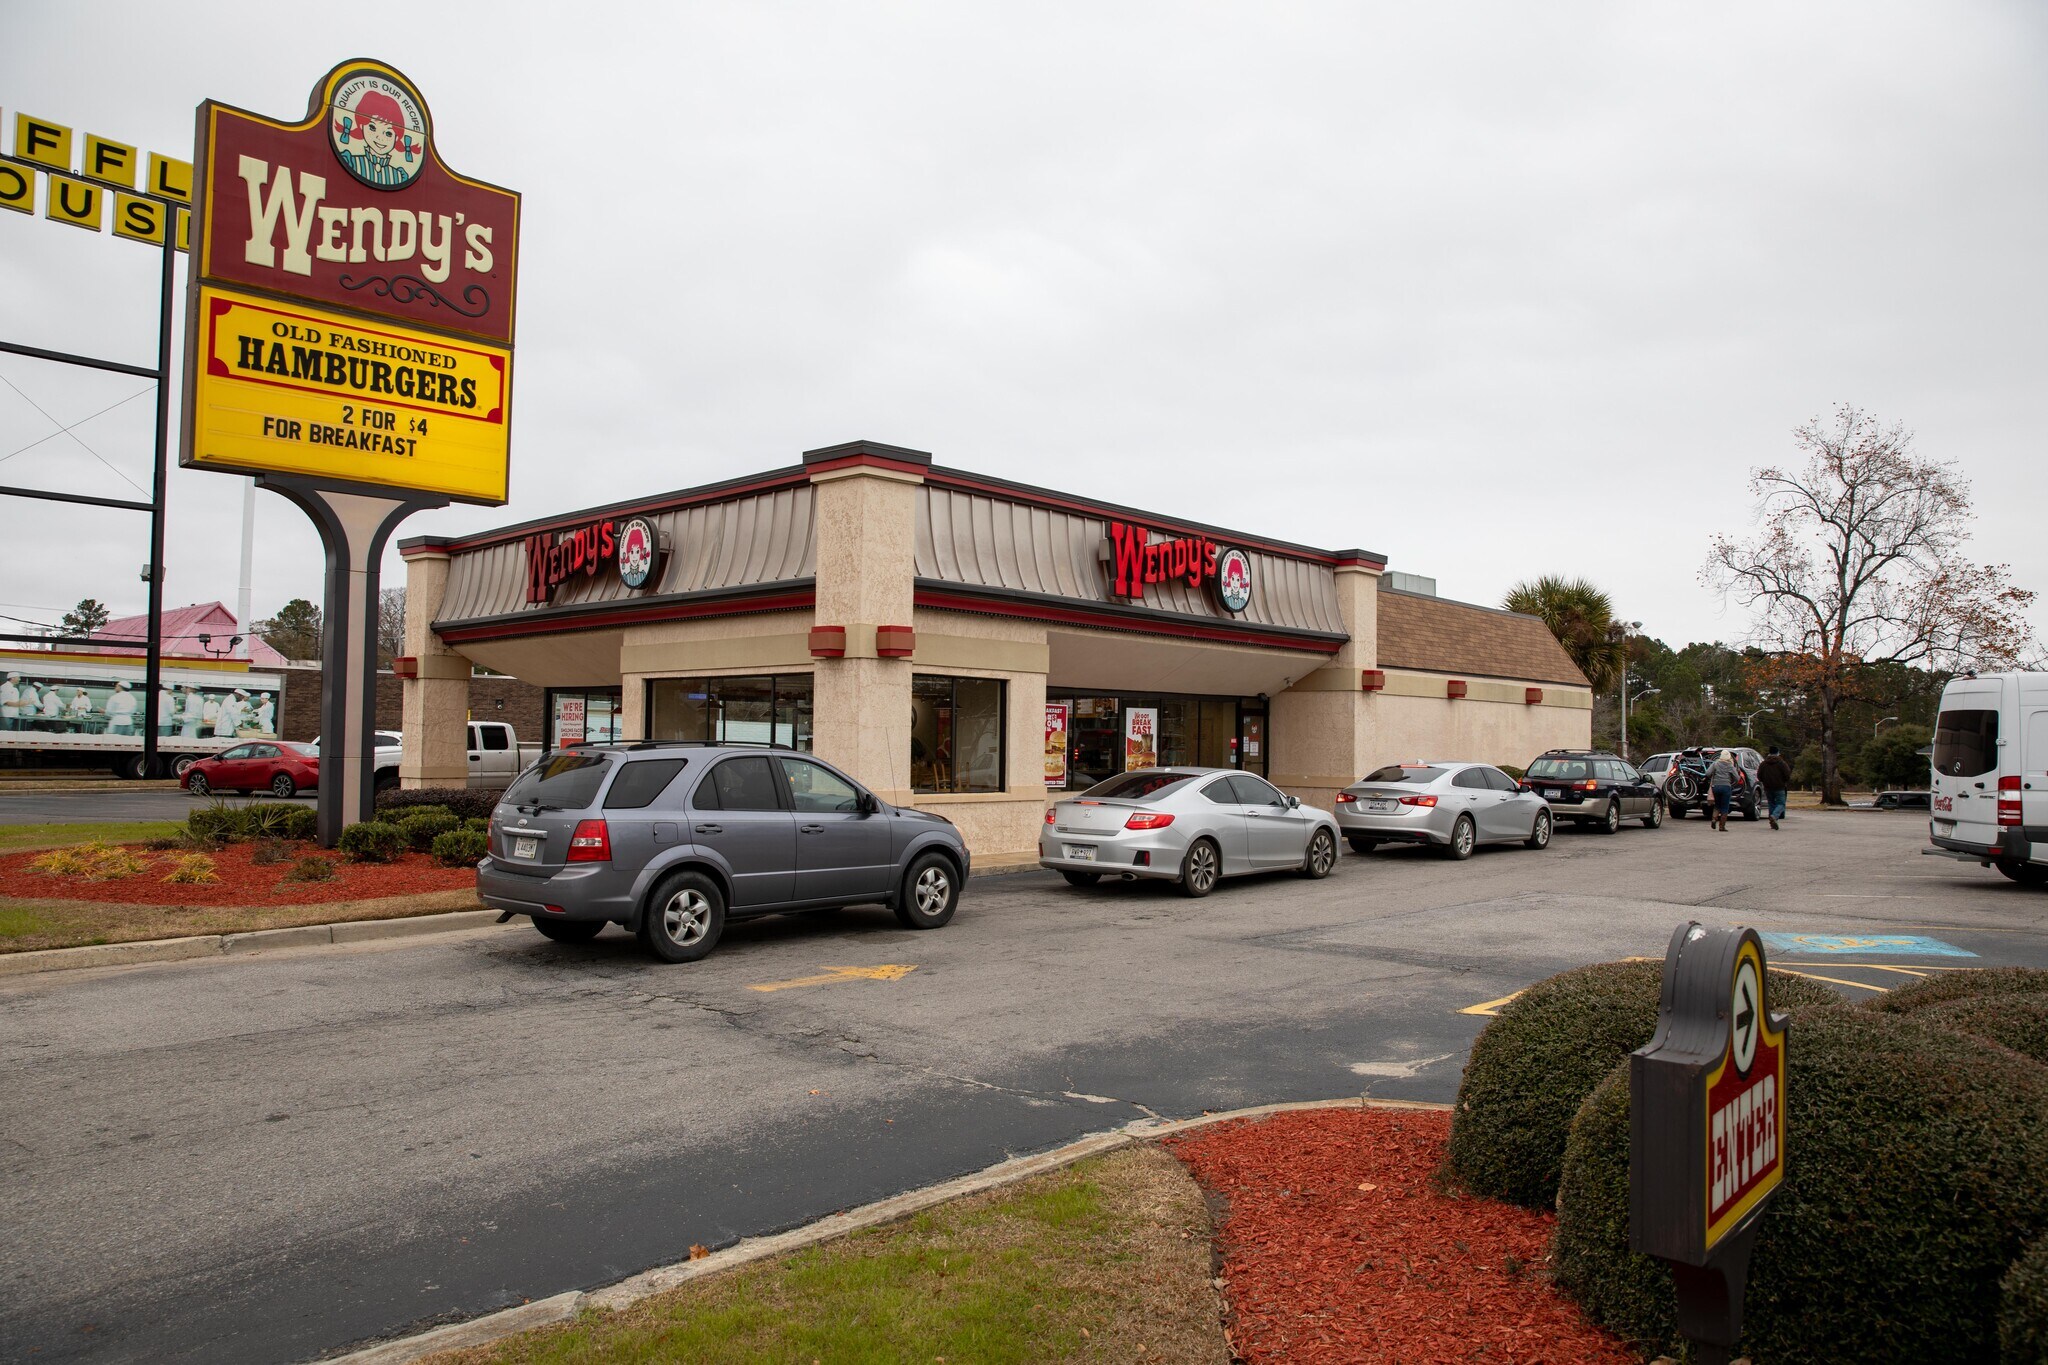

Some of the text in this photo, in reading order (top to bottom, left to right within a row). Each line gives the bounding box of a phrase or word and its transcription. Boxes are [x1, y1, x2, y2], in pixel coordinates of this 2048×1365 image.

[338, 80, 421, 132] QUALITY IS OUR RECIPE
[0, 167, 190, 246] OUS
[238, 154, 494, 283] Wendy's
[237, 334, 477, 409] HAMBURGERS
[272, 322, 457, 369] OLD FASHIONED
[263, 416, 417, 457] FOR BREAKFAST
[342, 405, 428, 436] 2 FOR $4
[525, 521, 614, 604] Wendy's
[1111, 521, 1217, 599] Wendy's
[561, 713, 584, 721] HIRING
[563, 702, 583, 711] WE'RE
[1132, 725, 1151, 735] FAST
[1712, 1074, 1776, 1214] ENTER
